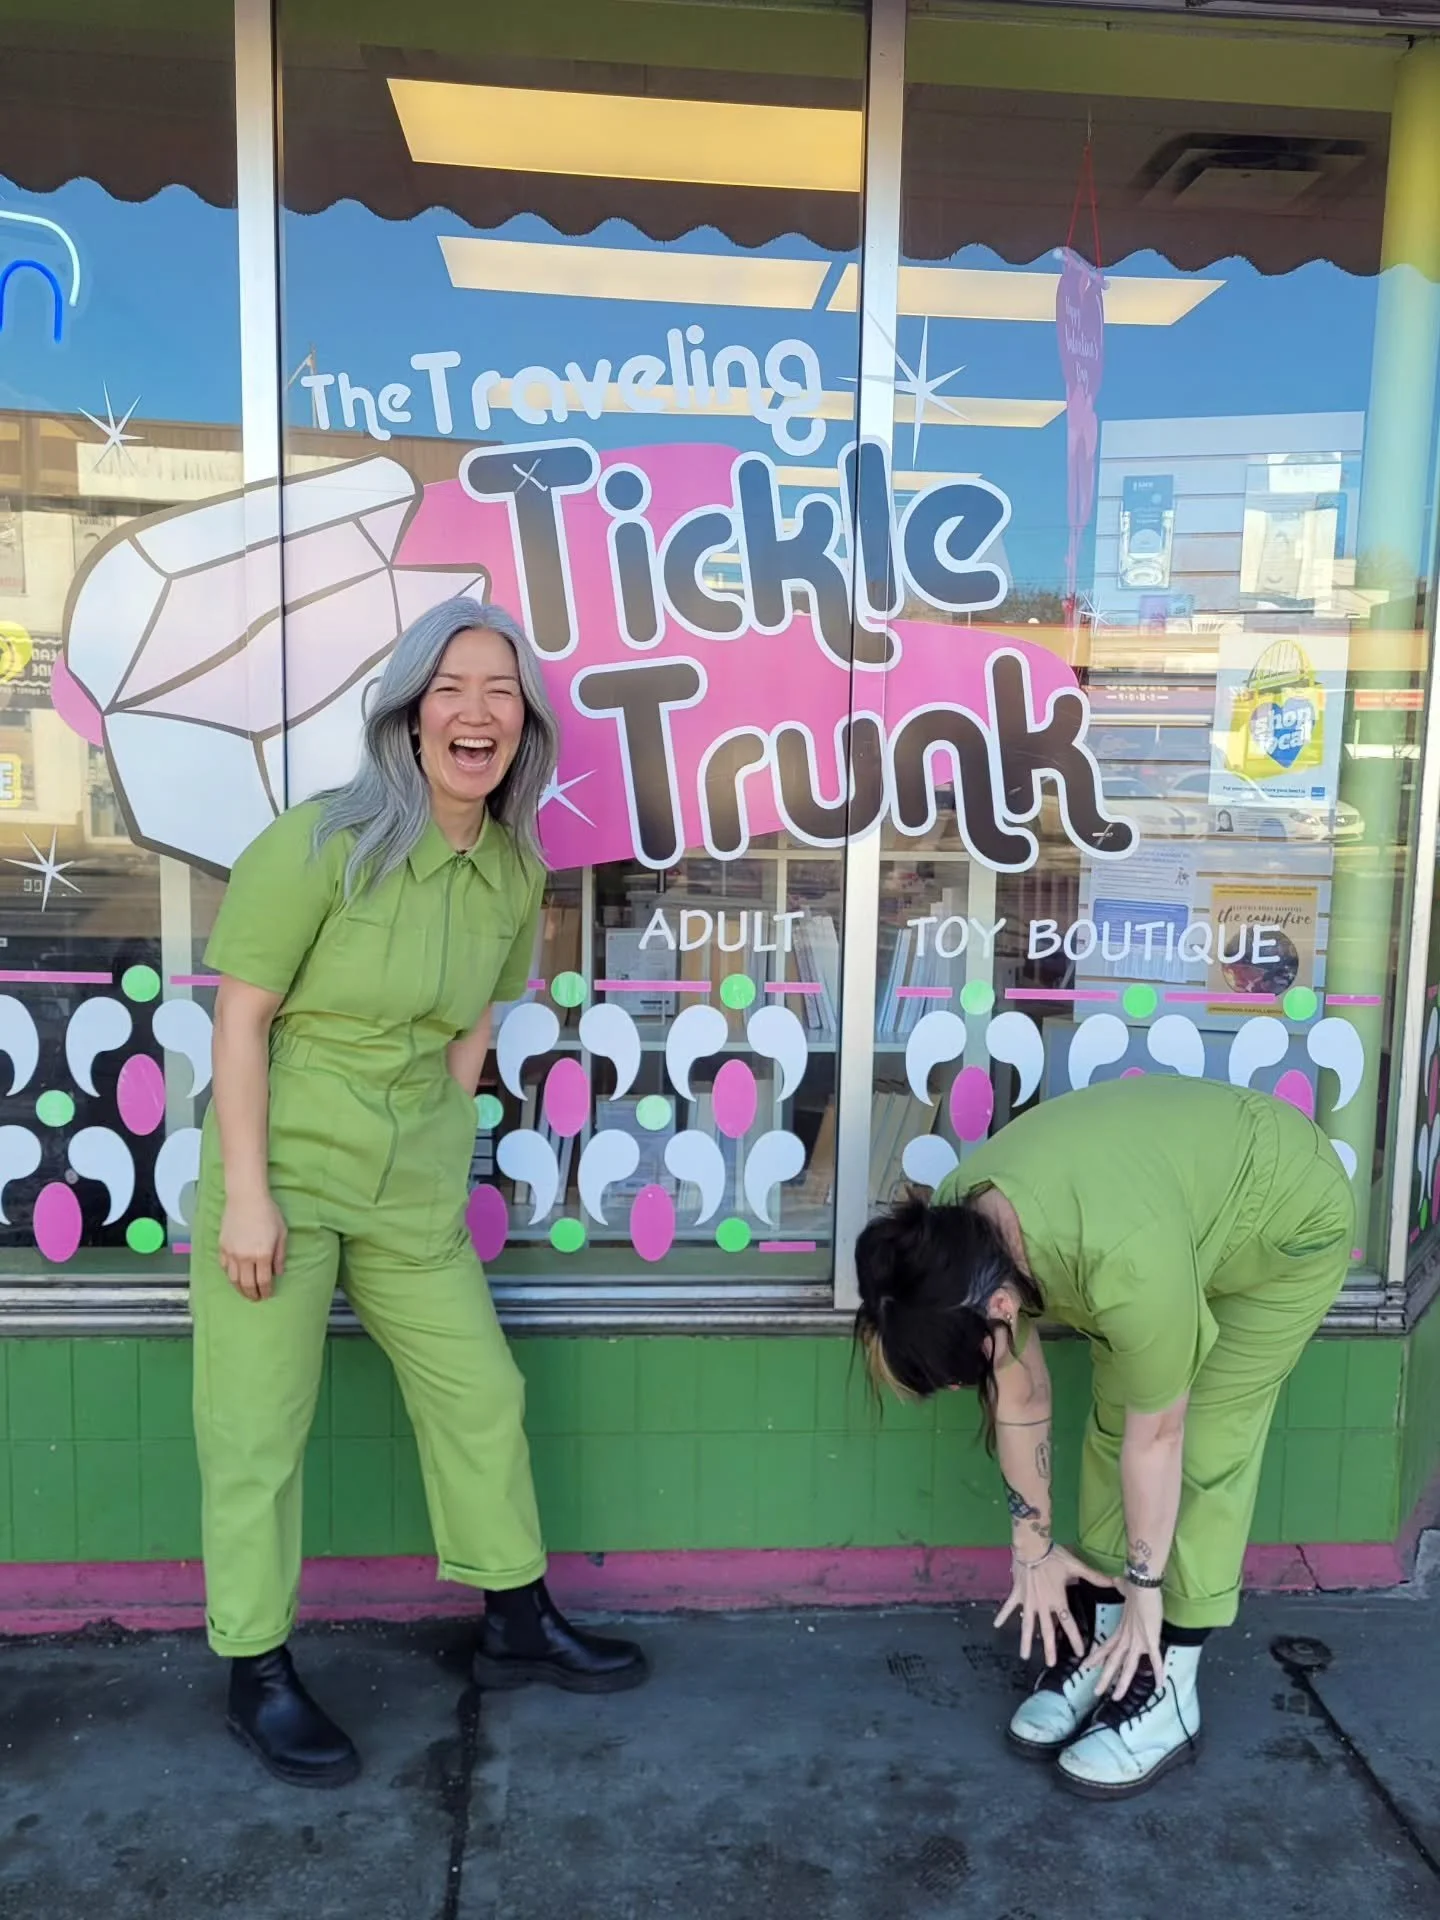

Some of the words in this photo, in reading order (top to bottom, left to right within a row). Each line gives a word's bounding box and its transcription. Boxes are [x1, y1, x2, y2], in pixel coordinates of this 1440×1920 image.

[301, 372, 412, 441] The
[411, 324, 826, 456] Traveling
[459, 435, 1012, 671] Tickle
[571, 647, 1140, 873] Trunk
[638, 908, 805, 952] ADULT
[907, 915, 1006, 959] TOY
[1028, 918, 1281, 964] BOUTIQUE
[1218, 906, 1241, 923] the
[1246, 911, 1312, 929] campfire
